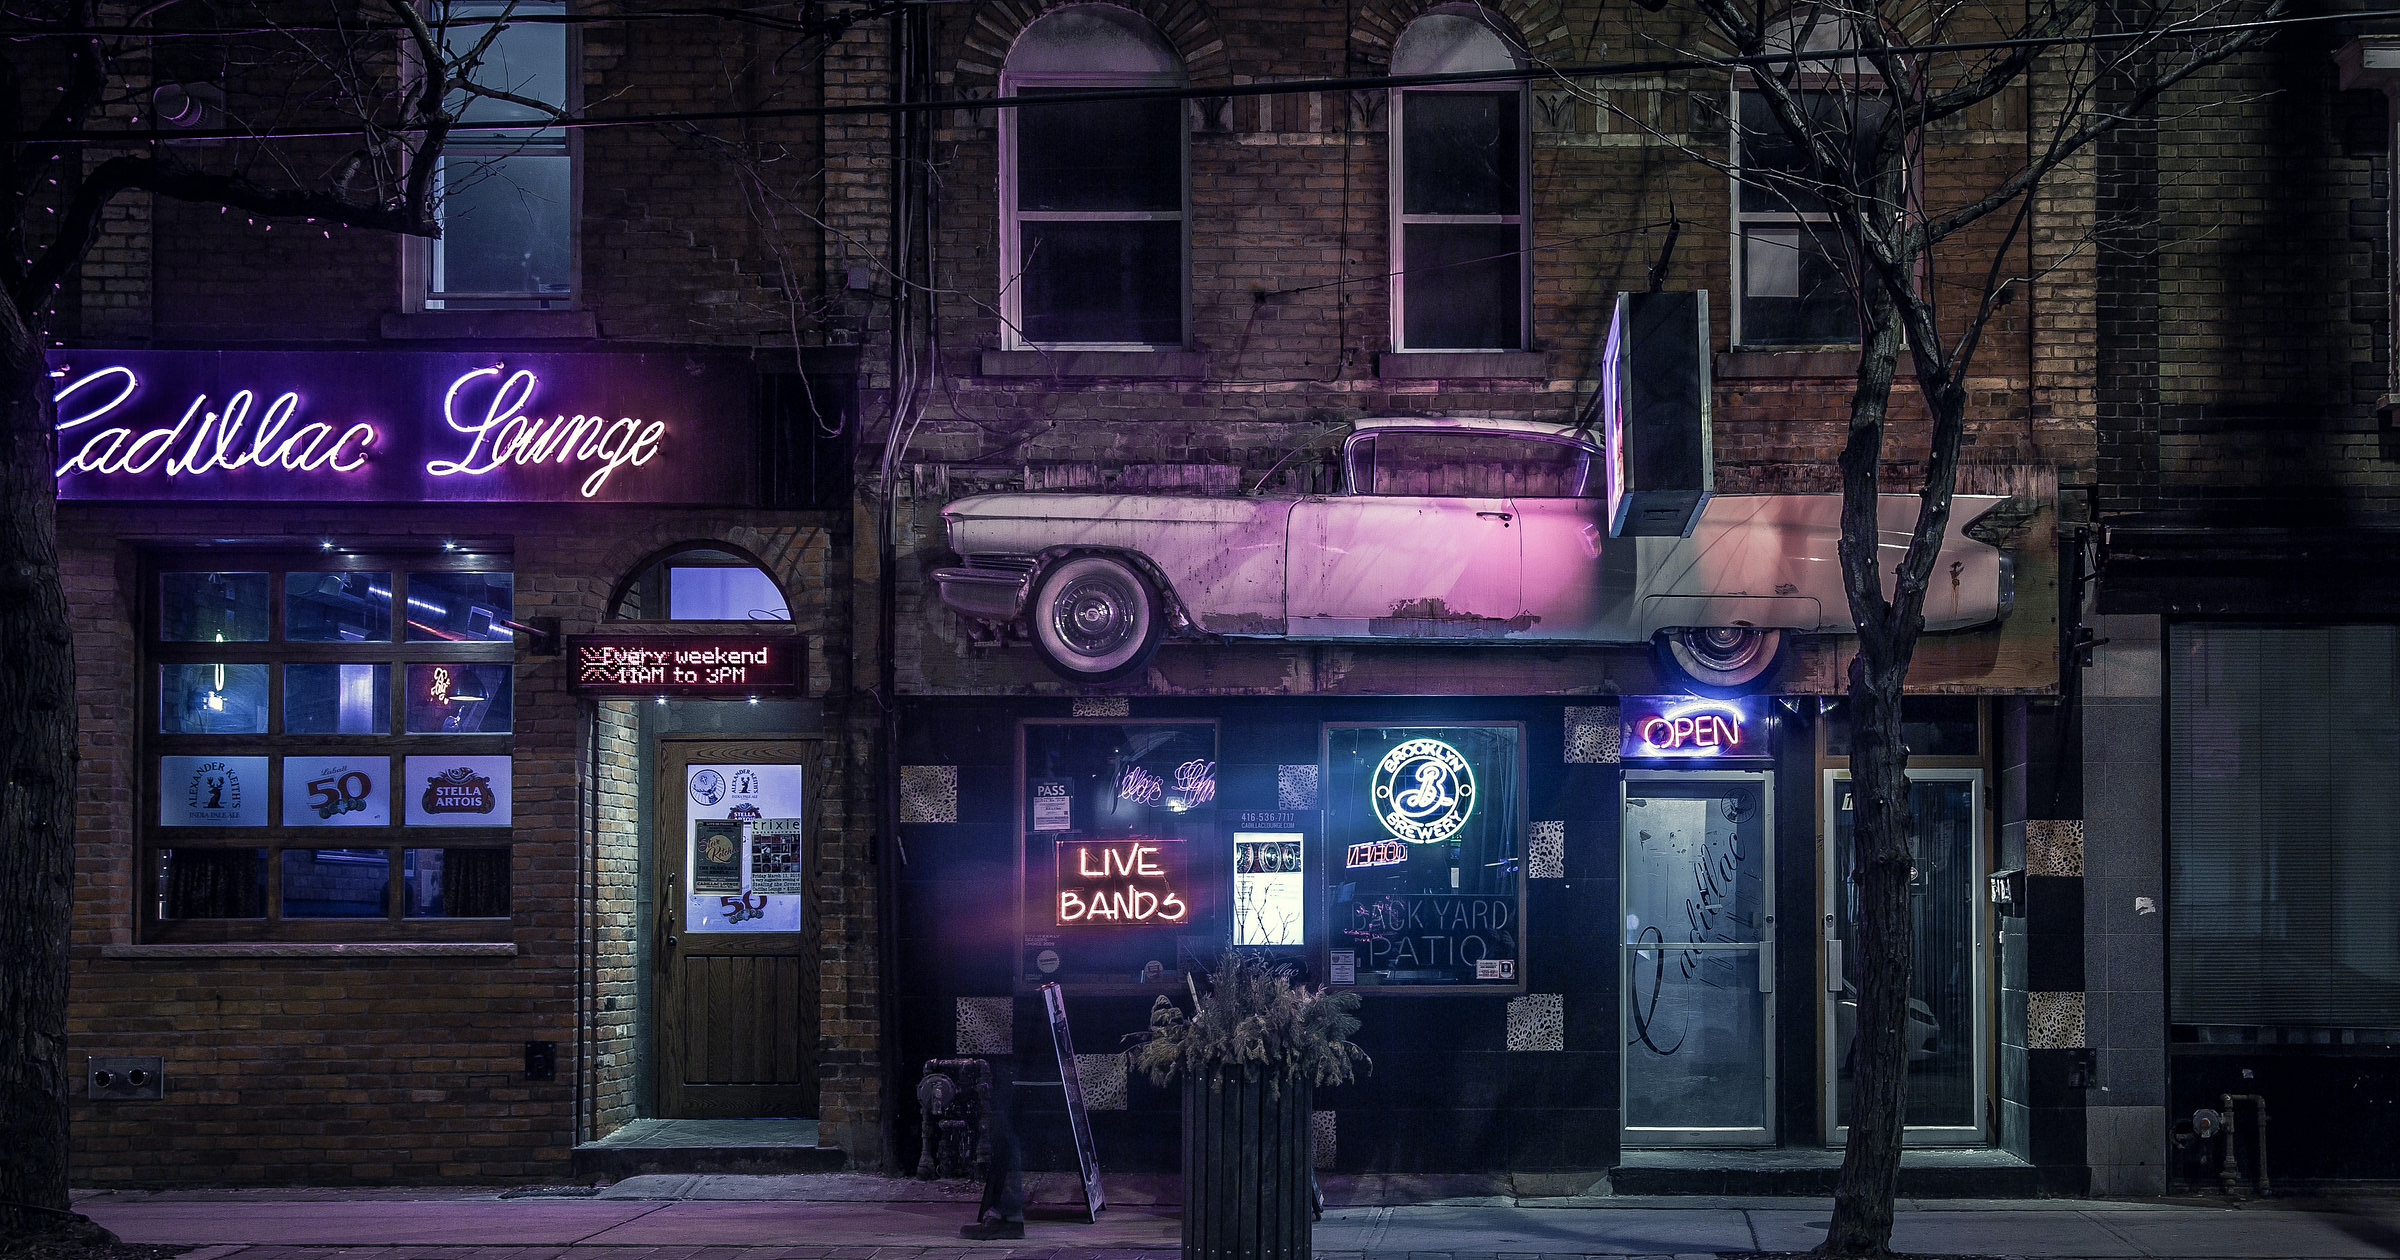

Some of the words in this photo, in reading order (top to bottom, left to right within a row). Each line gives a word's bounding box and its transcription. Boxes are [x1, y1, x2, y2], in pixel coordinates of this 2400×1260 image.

[427, 369, 665, 498] Lounge
[602, 646, 666, 665] Every
[675, 646, 768, 665] weekend
[673, 667, 698, 684] to
[706, 667, 745, 684] 3PM
[1644, 713, 1738, 749] OPEN
[320, 766, 348, 775] Labatt
[1383, 743, 1464, 774] BROOKLYN
[188, 762, 226, 809] ALEXANDER
[225, 768, 241, 809] KEITH'S
[307, 771, 372, 810] 50
[436, 786, 482, 796] STELLA
[1037, 785, 1066, 797] PASS
[435, 797, 483, 807] ARTOIS
[1241, 812, 1294, 821] 416-536-7717
[752, 818, 800, 830] trixie
[1386, 810, 1462, 840] BREWERY
[1080, 843, 1165, 876] LIVE
[1061, 885, 1186, 920] BANDS
[1351, 900, 1424, 931] BACK
[1433, 900, 1508, 930] YARD
[1369, 935, 1487, 967] PATIO
